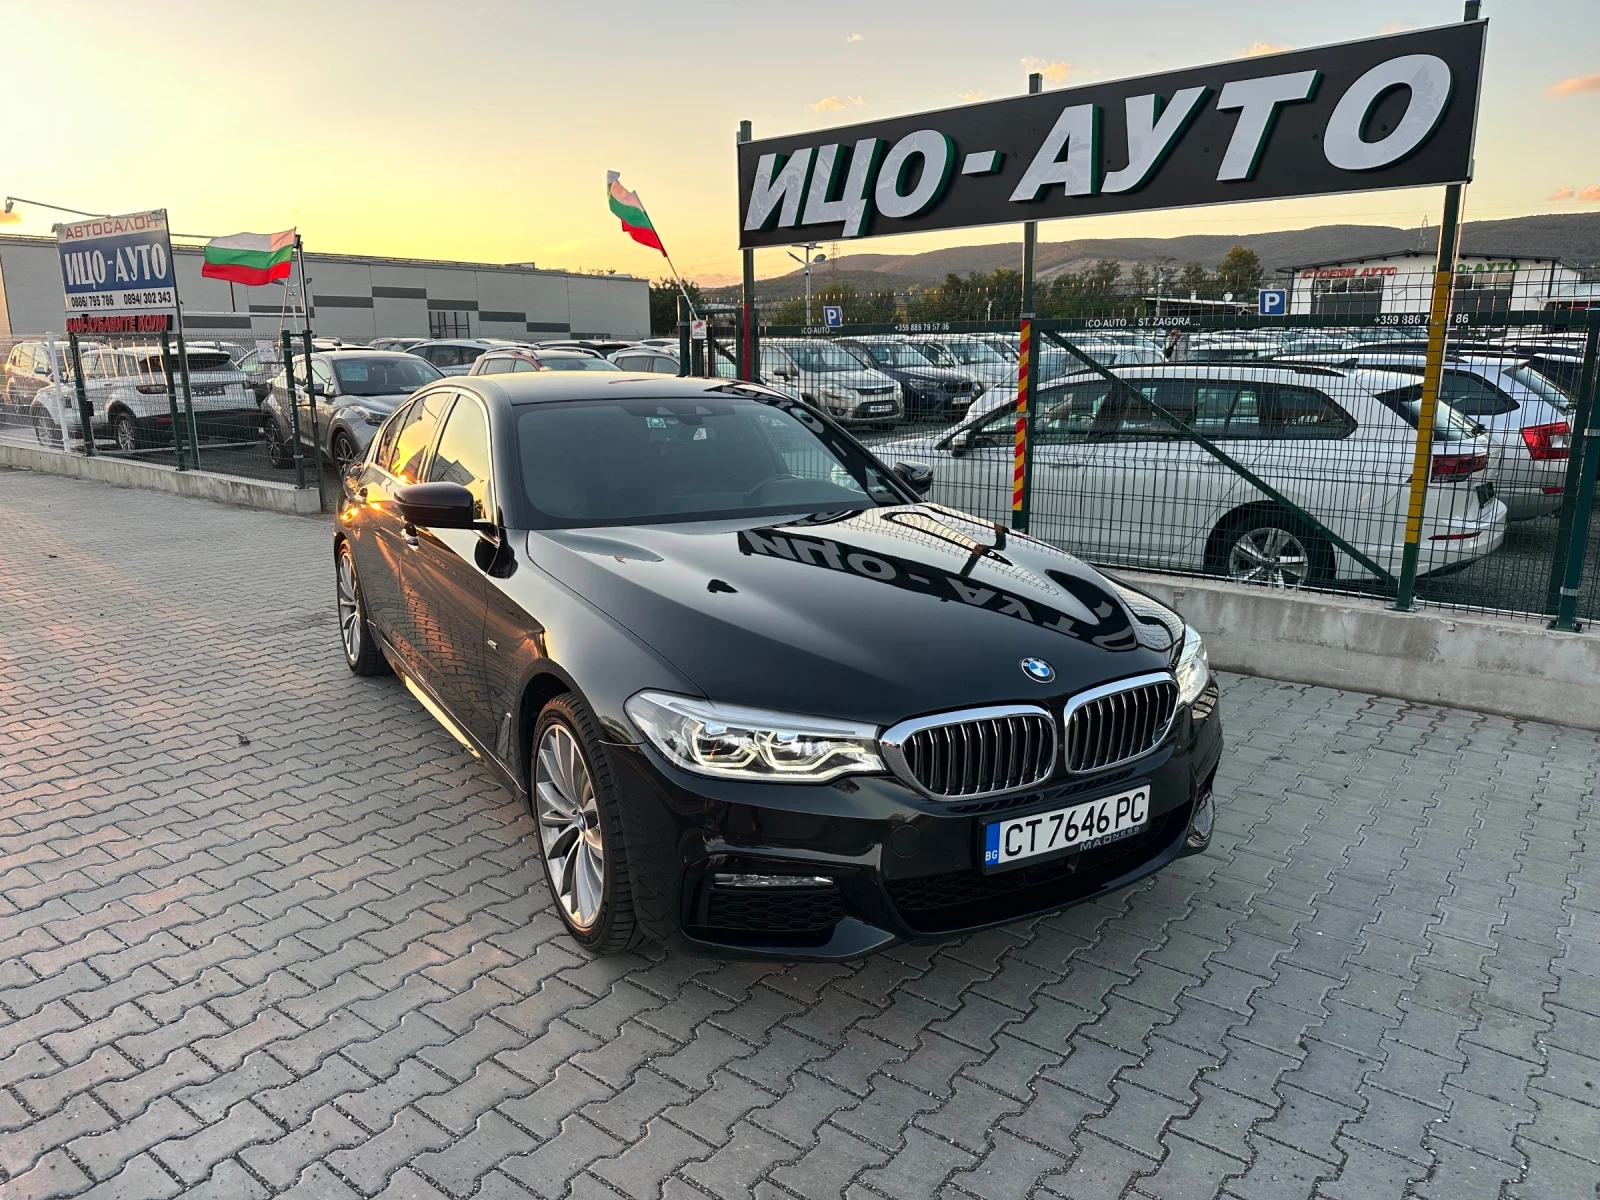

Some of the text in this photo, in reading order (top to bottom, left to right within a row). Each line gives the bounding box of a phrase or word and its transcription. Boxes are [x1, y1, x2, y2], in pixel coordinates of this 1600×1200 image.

[65, 214, 158, 239] АВТОСАЛОН
[1359, 267, 1397, 277] АУТО
[89, 296, 100, 307] 795
[101, 295, 114, 306] 786
[143, 292, 156, 304] 302
[158, 291, 171, 303] 343
[1265, 293, 1280, 312] P
[138, 314, 167, 331] КОЛИ
[827, 309, 837, 325] P
[1152, 317, 1191, 326] ZAGORA
[1373, 315, 1398, 325] +359
[1005, 792, 1145, 857] CT 7646 PC
[985, 849, 998, 861] BG
